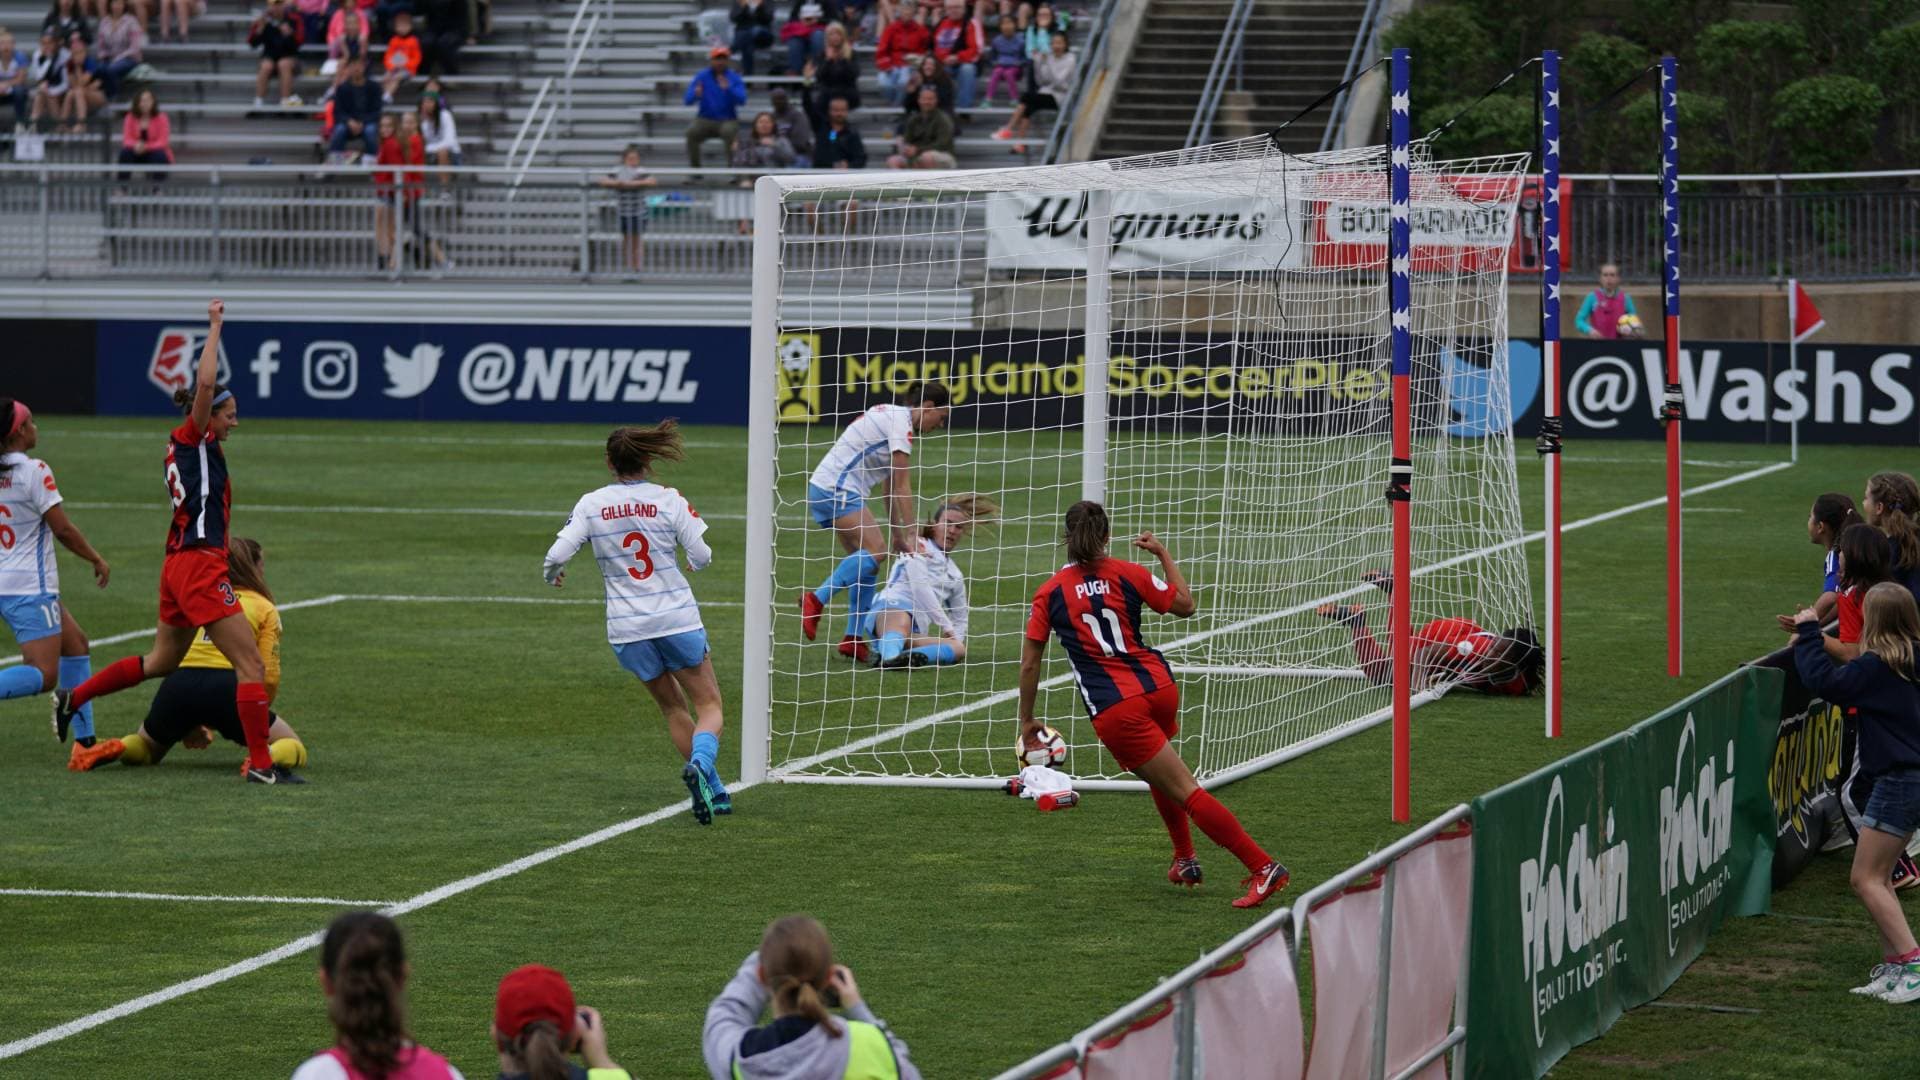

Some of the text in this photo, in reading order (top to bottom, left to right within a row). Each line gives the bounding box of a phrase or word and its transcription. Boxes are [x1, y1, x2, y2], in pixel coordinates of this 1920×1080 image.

[1018, 190, 1265, 258] Wgmans
[458, 342, 699, 405] @NWSL
[846, 353, 1086, 405] Maryland
[1568, 348, 1914, 430] @WashS
[601, 503, 658, 521] GILLILAND
[622, 531, 654, 581] 3
[1075, 579, 1110, 600] PUGH
[1081, 608, 1128, 658] 11
[1520, 775, 1629, 984] ProChain
